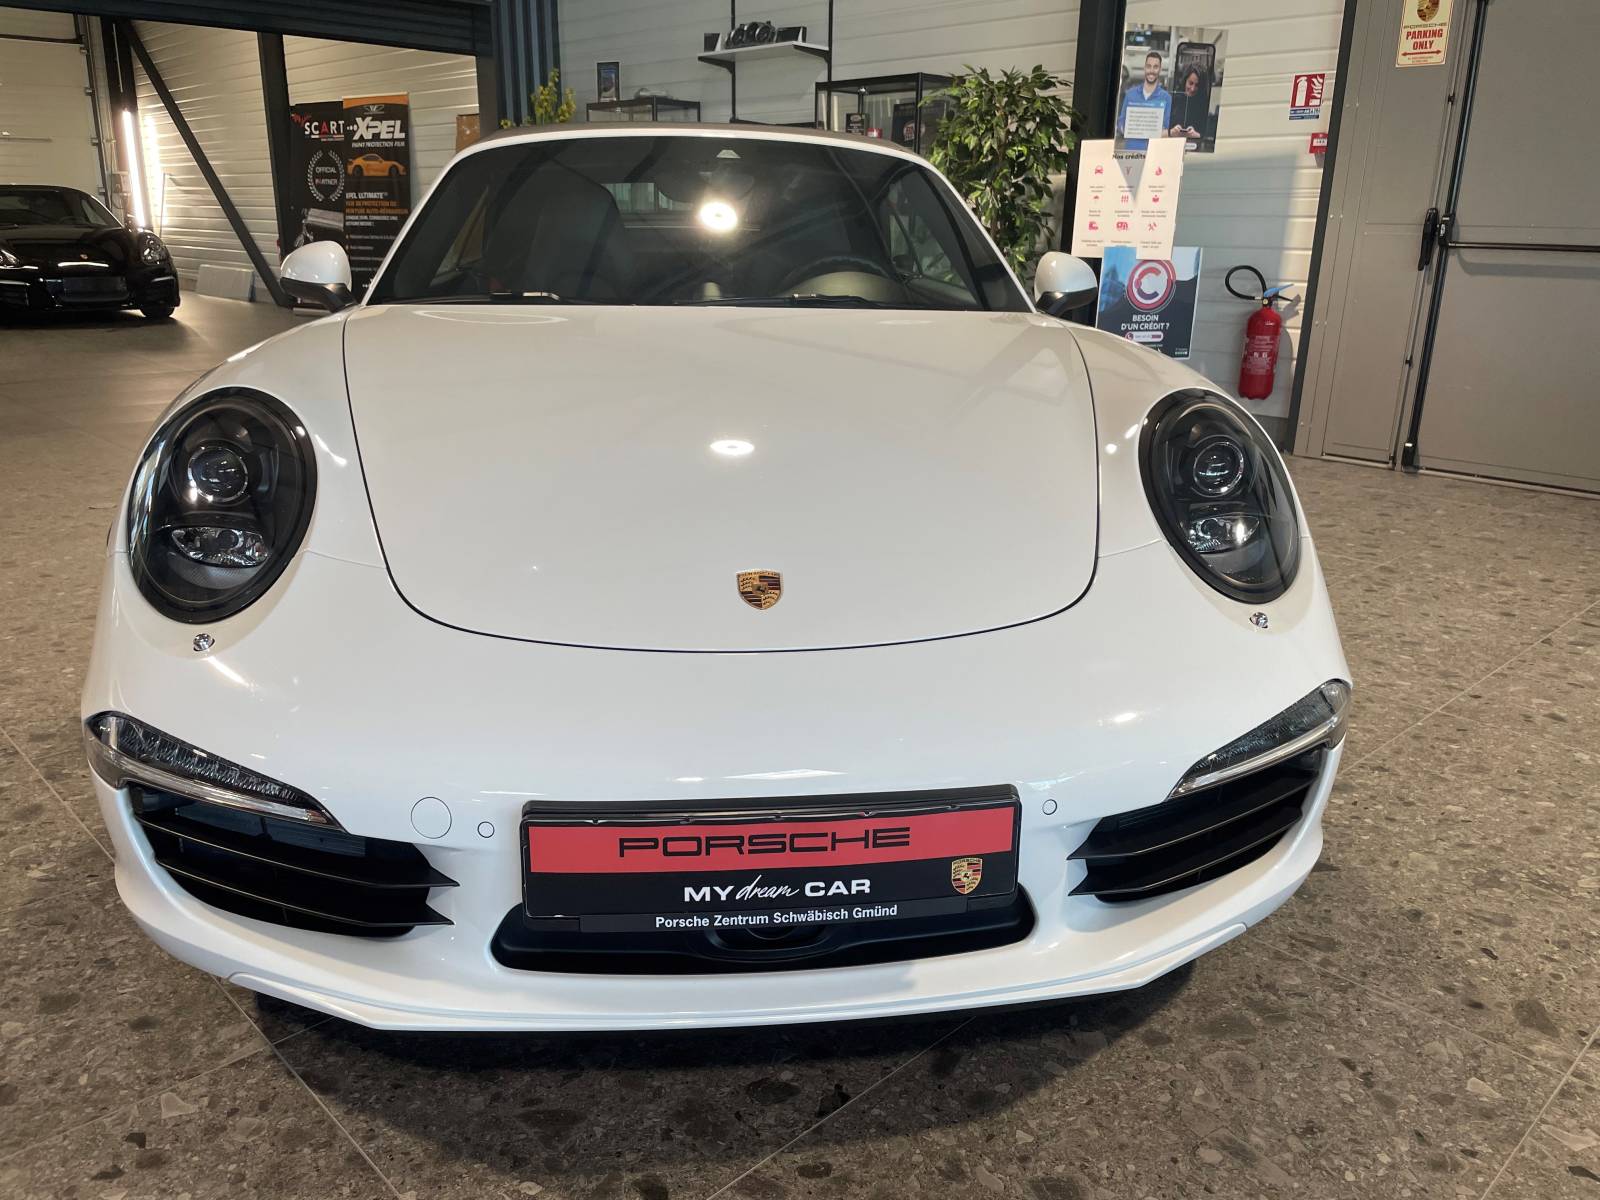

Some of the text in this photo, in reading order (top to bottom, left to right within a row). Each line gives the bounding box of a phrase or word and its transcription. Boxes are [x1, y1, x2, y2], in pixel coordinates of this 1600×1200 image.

[1407, 29, 1443, 40] PARKING
[1413, 40, 1434, 50] ONLY
[304, 120, 345, 135] SCART
[352, 116, 406, 140] XPEL
[315, 166, 337, 174] OFFICIAL
[1132, 314, 1159, 322] BESOIN
[1121, 323, 1139, 331] D'UN
[1140, 321, 1166, 330] CRÉDIT
[619, 826, 911, 858] PORSCHE
[684, 874, 871, 902] MY dream CAR
[655, 904, 898, 928] Porsche Zentrum Schwäbisch Gmünd
